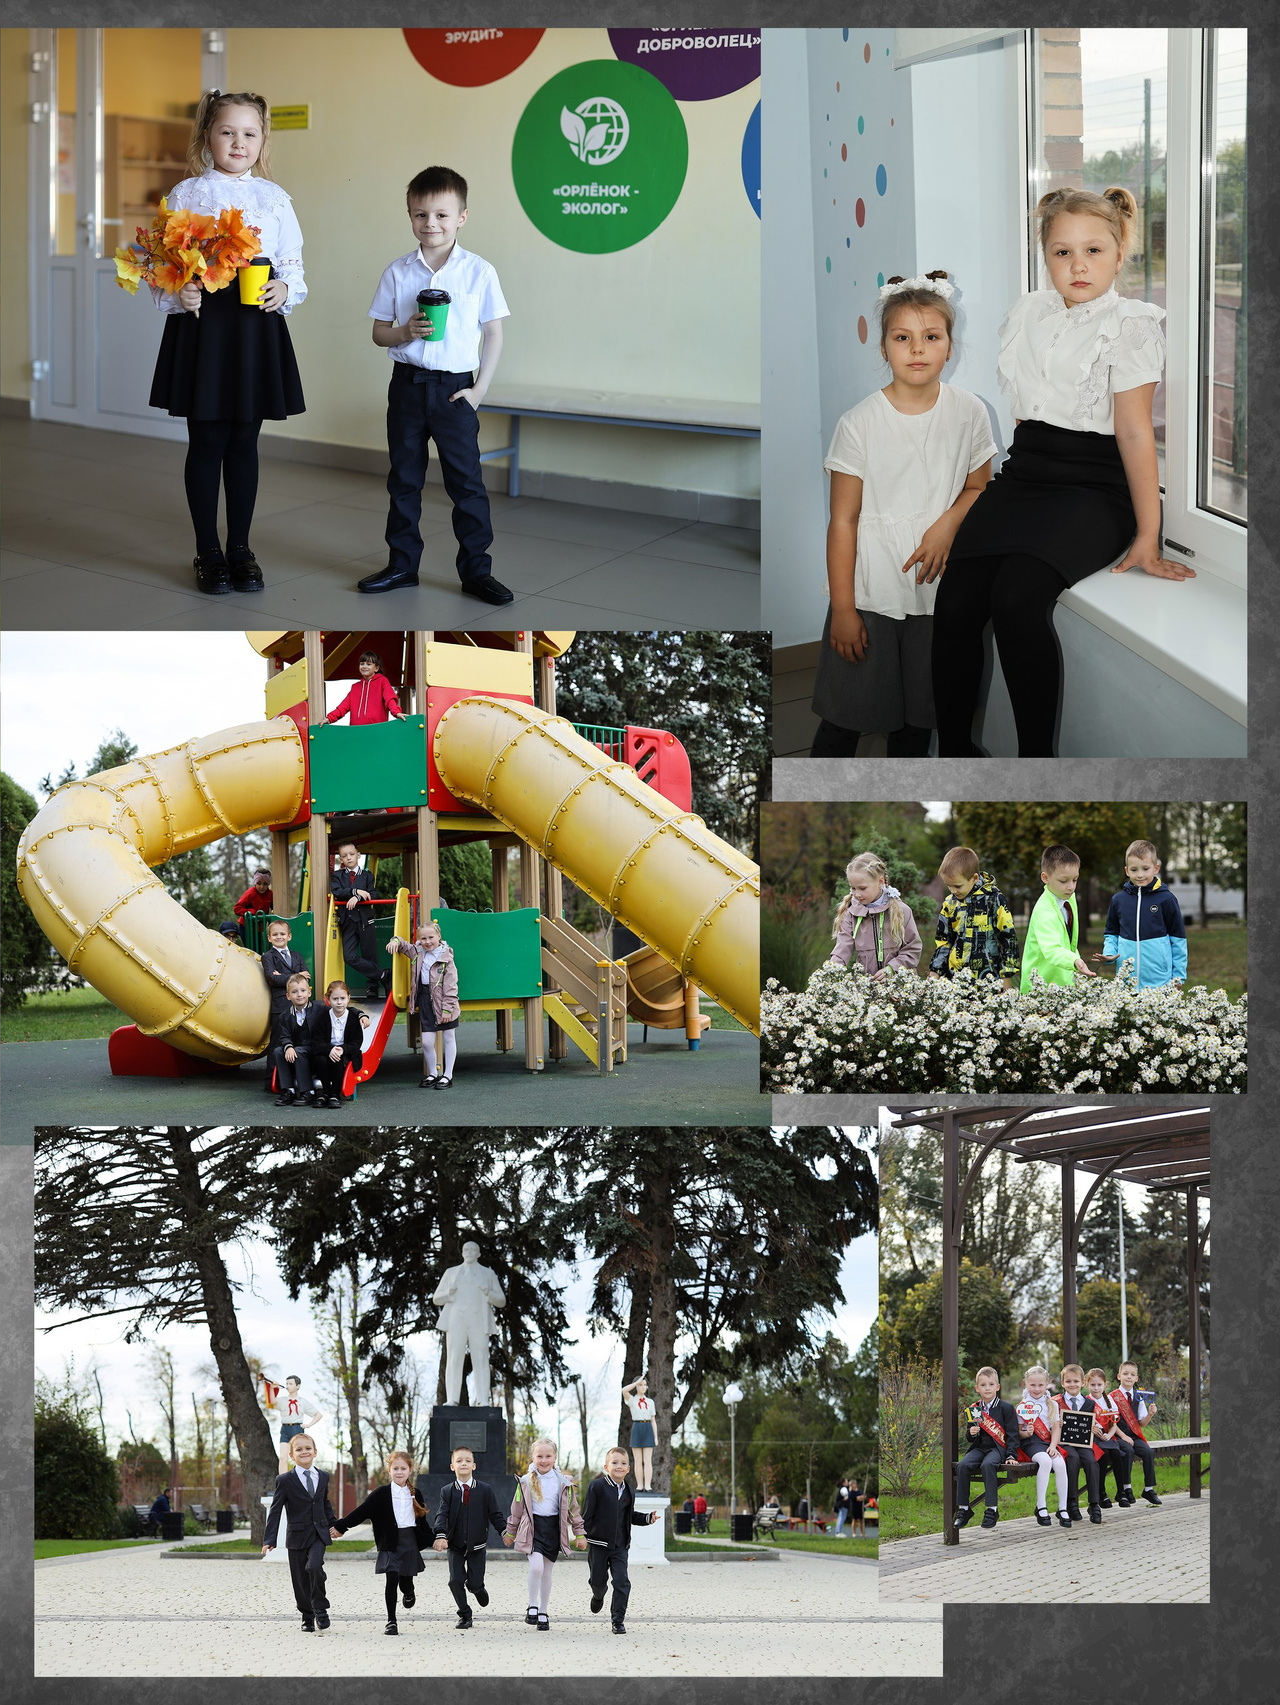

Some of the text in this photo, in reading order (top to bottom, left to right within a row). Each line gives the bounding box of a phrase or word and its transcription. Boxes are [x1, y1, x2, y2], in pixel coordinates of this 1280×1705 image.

[445, 28, 504, 44] ЭРУДИТ»
[637, 33, 762, 54] ДОБРОВОЛЕЦ»
[552, 182, 630, 197] «ОРЛЁНОК
[561, 202, 628, 215] ЭКОЛОГ»
